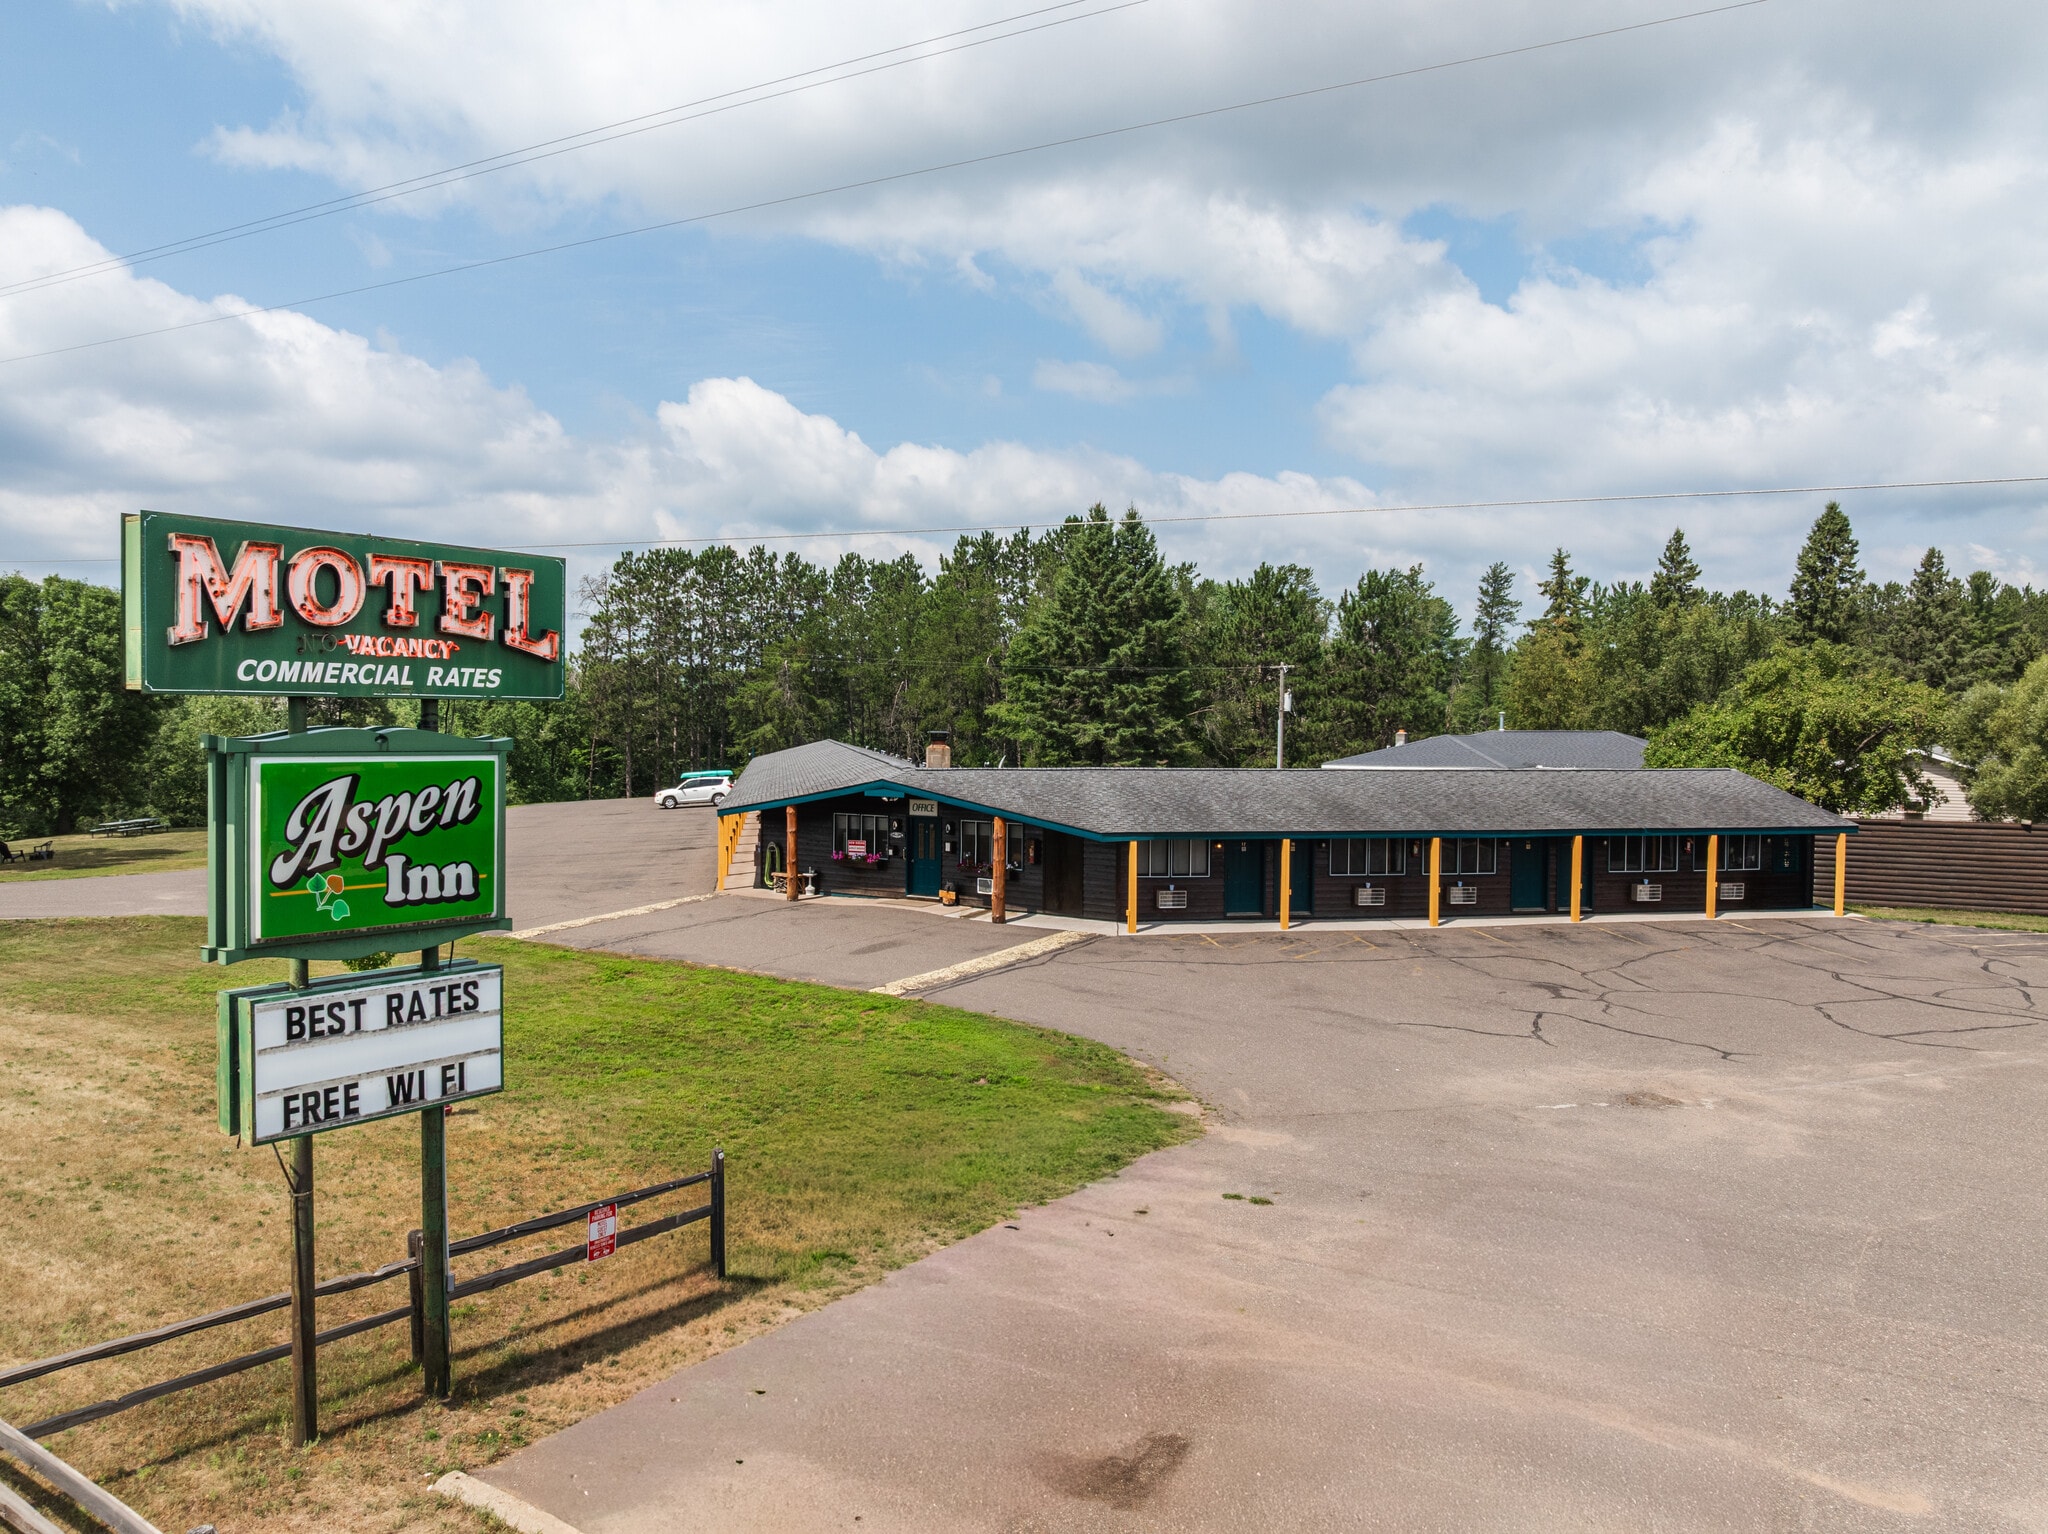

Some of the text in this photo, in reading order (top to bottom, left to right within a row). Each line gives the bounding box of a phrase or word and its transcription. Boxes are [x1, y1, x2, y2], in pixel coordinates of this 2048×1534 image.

[167, 532, 559, 662] MOTEL
[237, 659, 502, 688] COMMERCIAL RATES
[342, 634, 456, 660] VACANCY
[270, 774, 481, 888] Aspen
[912, 803, 935, 812] OFFICE
[385, 854, 479, 905] Inn
[286, 980, 480, 1041] BEST RATES
[283, 1062, 466, 1129] FREE WI FI
